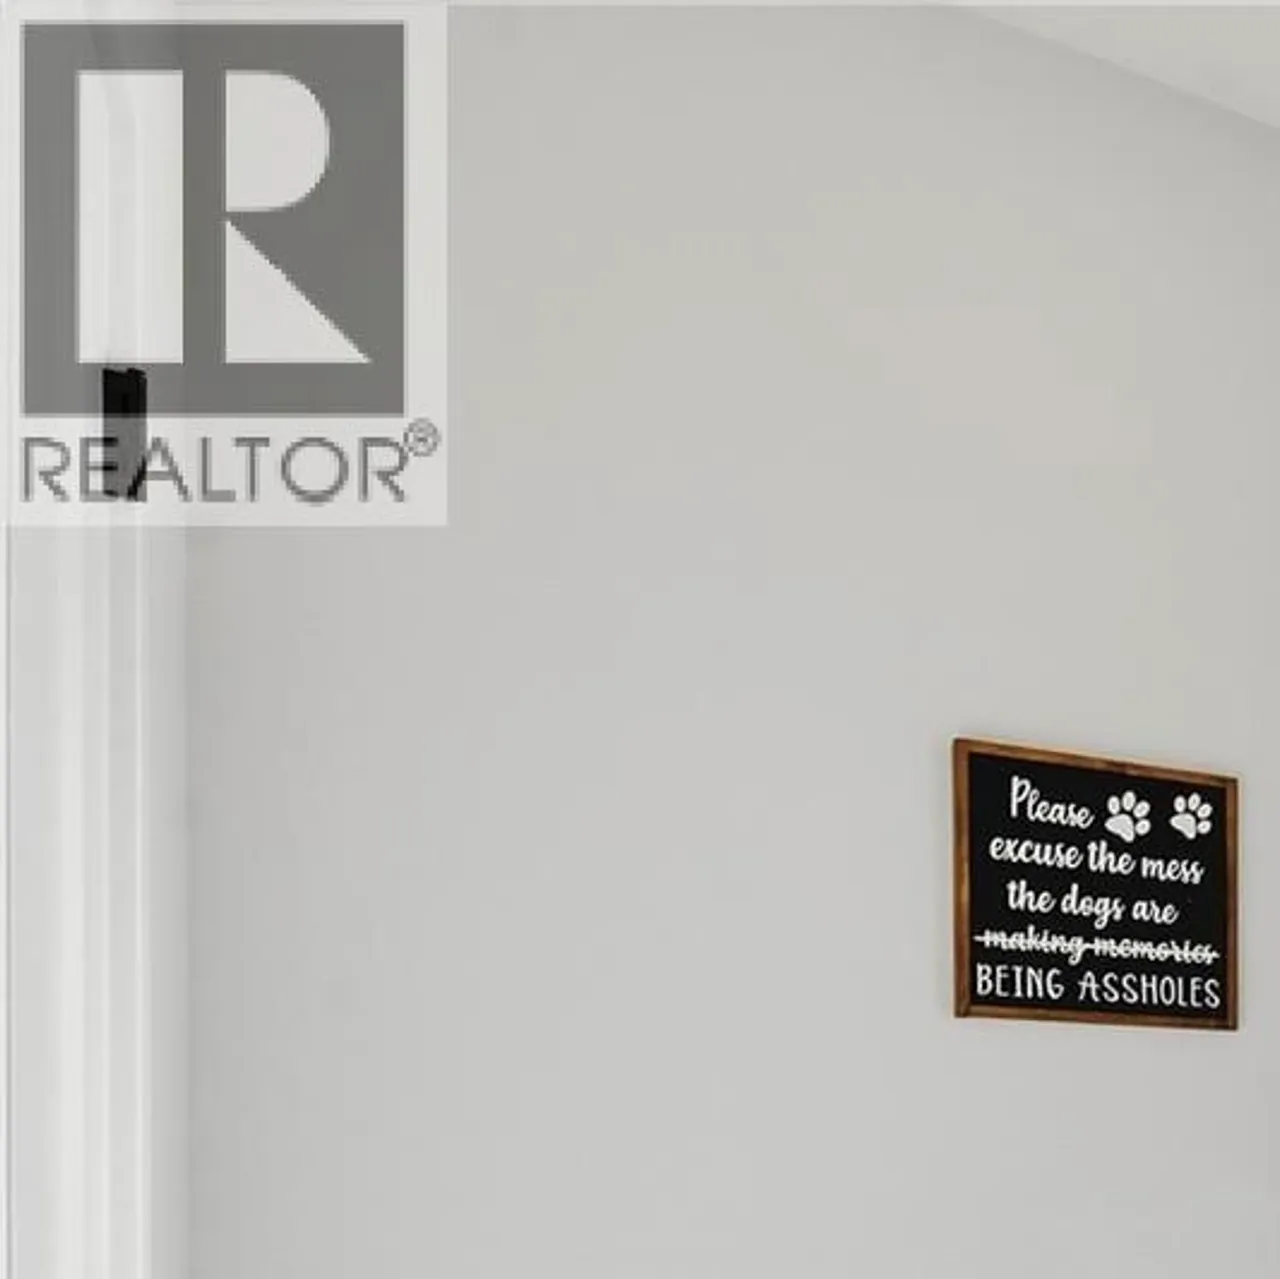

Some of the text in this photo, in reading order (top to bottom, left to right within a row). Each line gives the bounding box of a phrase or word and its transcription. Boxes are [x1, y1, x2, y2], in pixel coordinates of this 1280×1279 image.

[1009, 775, 1094, 828] Please
[989, 837, 1205, 885] excuse the mess
[1007, 880, 1179, 929] the dogs are
[980, 925, 1218, 965] making memories
[976, 963, 1221, 1008] BEING ASSHOLES
